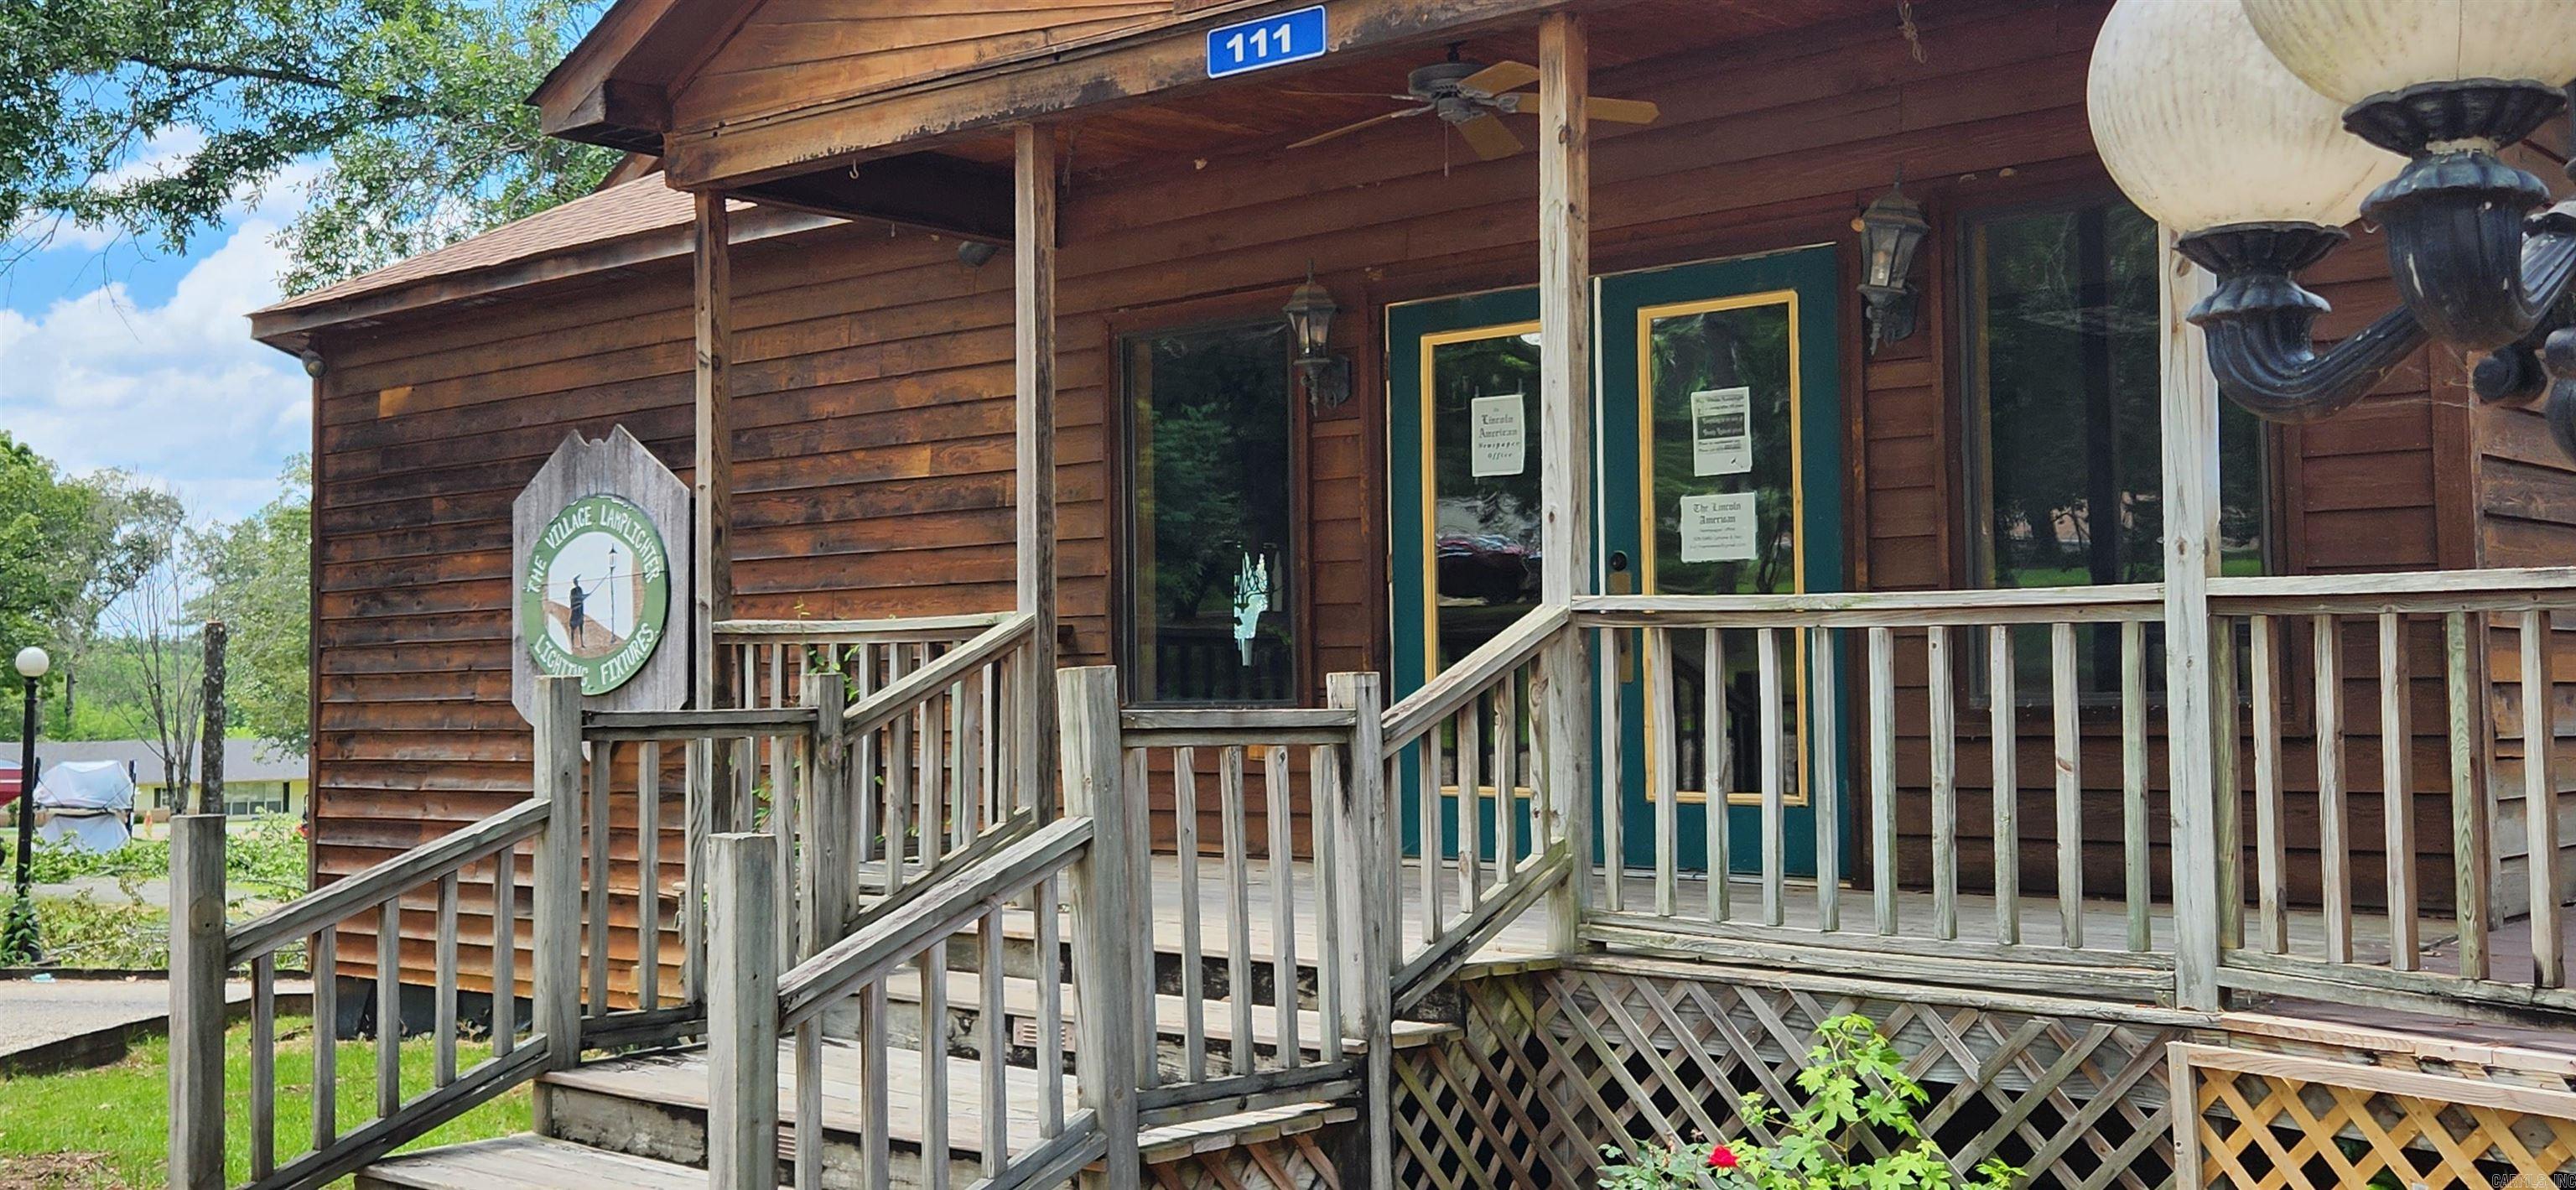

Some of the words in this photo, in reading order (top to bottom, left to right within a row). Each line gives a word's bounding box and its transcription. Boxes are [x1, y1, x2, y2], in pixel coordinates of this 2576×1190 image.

[1226, 23, 1291, 63] 111
[526, 554, 548, 593] THE
[544, 506, 593, 549] VILLAGE
[600, 504, 660, 584] LAMPLIGHTER
